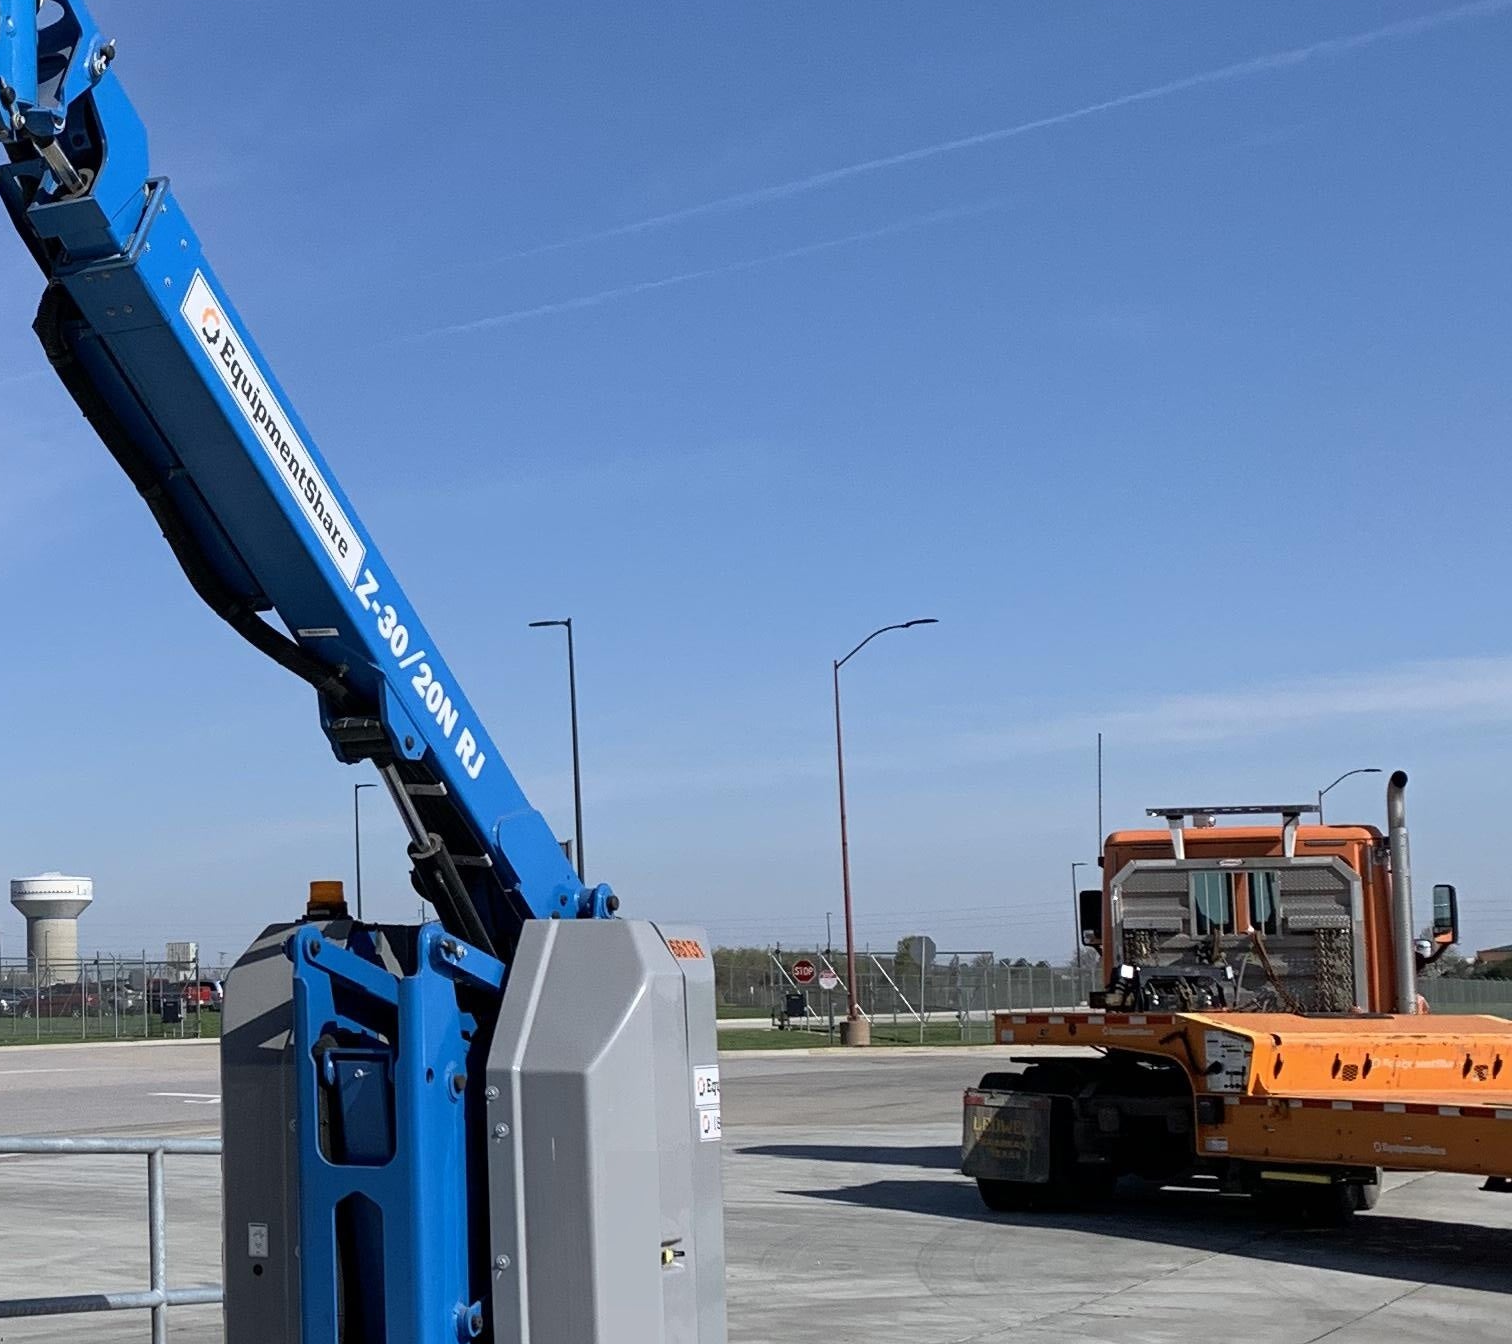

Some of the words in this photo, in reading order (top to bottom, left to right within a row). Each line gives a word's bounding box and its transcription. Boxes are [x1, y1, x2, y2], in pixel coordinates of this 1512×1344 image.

[219, 336, 349, 558] EquipmentShare
[355, 568, 459, 739] Z-30/20N
[455, 727, 486, 780] RJ
[794, 966, 814, 976] STOP
